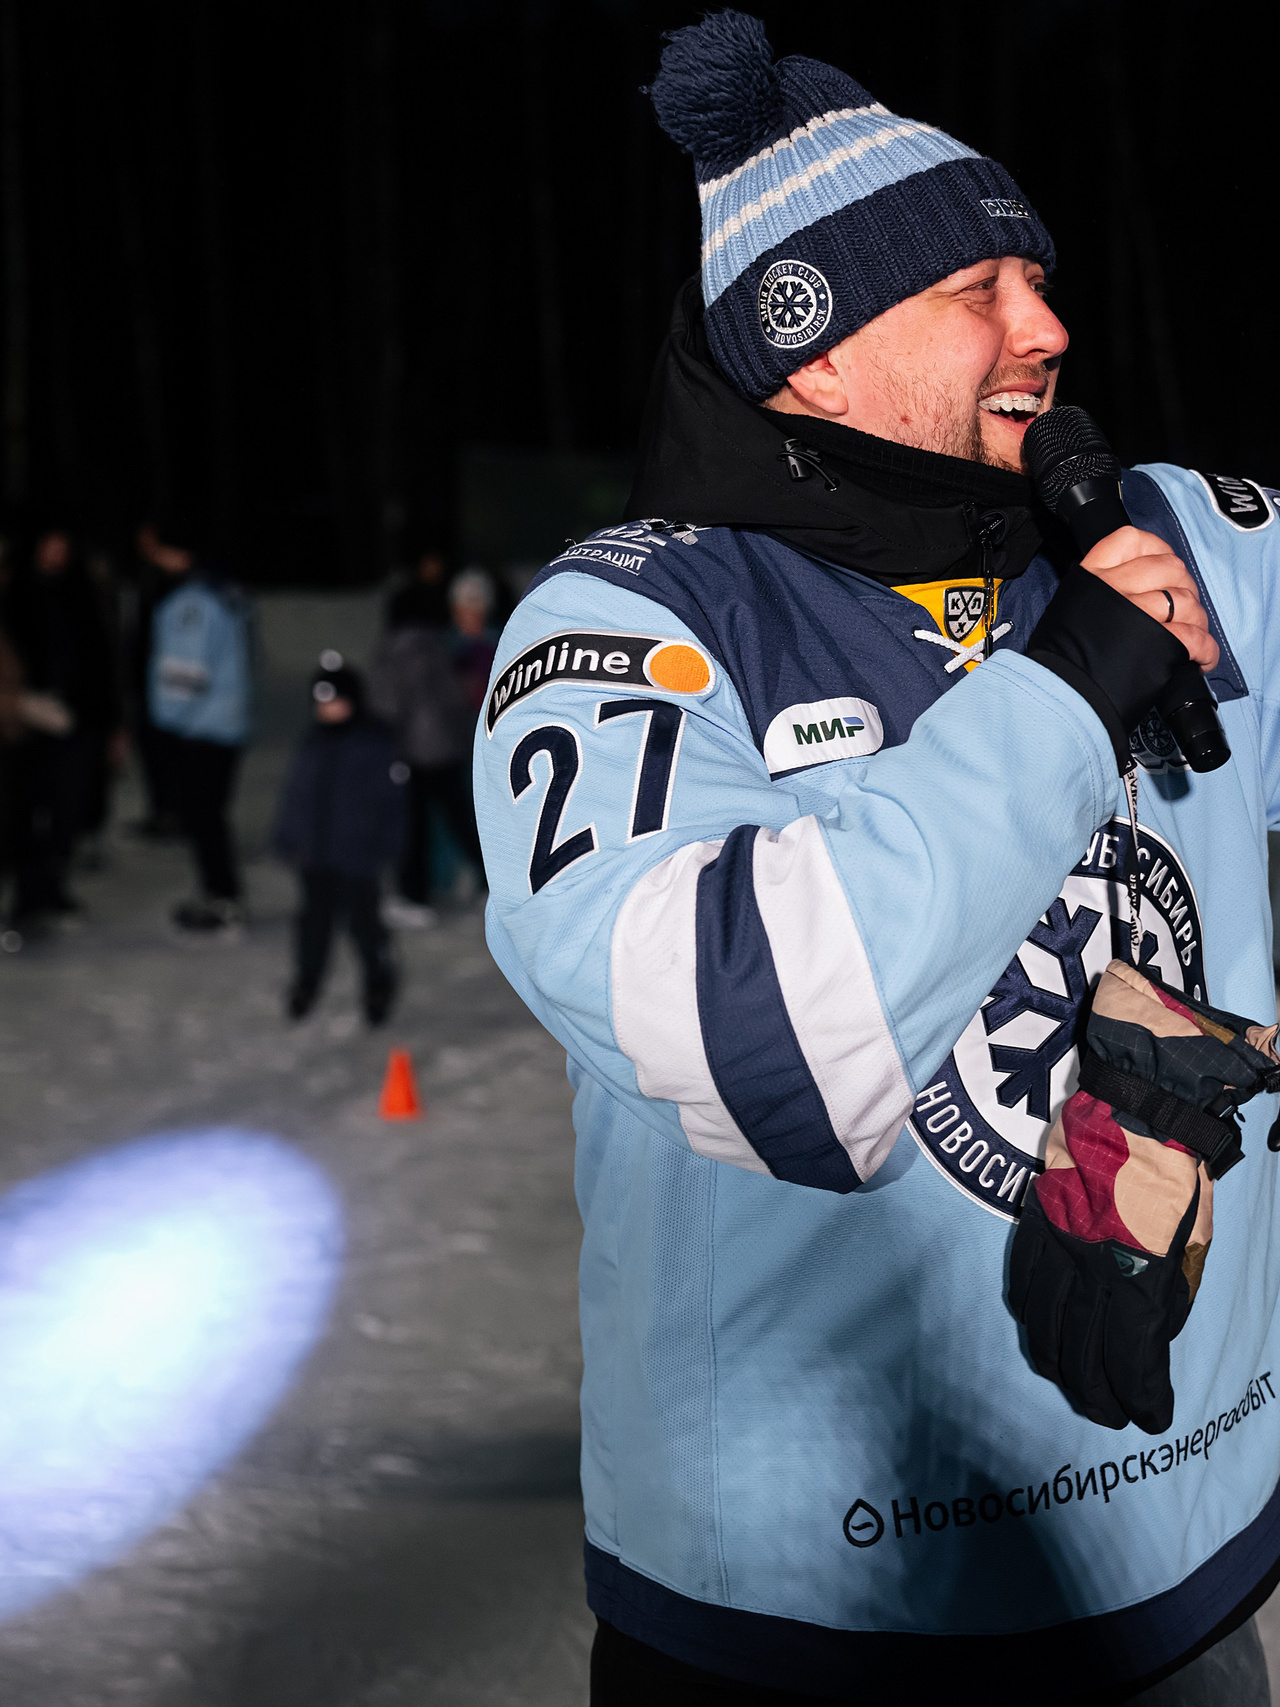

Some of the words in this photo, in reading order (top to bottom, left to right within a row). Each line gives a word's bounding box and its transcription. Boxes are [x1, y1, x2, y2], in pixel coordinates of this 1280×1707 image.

[763, 264, 793, 289] HOCKEY
[798, 266, 822, 288] CLUB
[760, 291, 769, 322] SIBIR
[774, 309, 827, 345] NOVOSIBIRSK
[792, 716, 865, 746] МИР
[509, 698, 687, 896] 27
[1136, 846, 1199, 967] СИБИРЬ
[916, 1081, 1040, 1207] НОВОСИ
